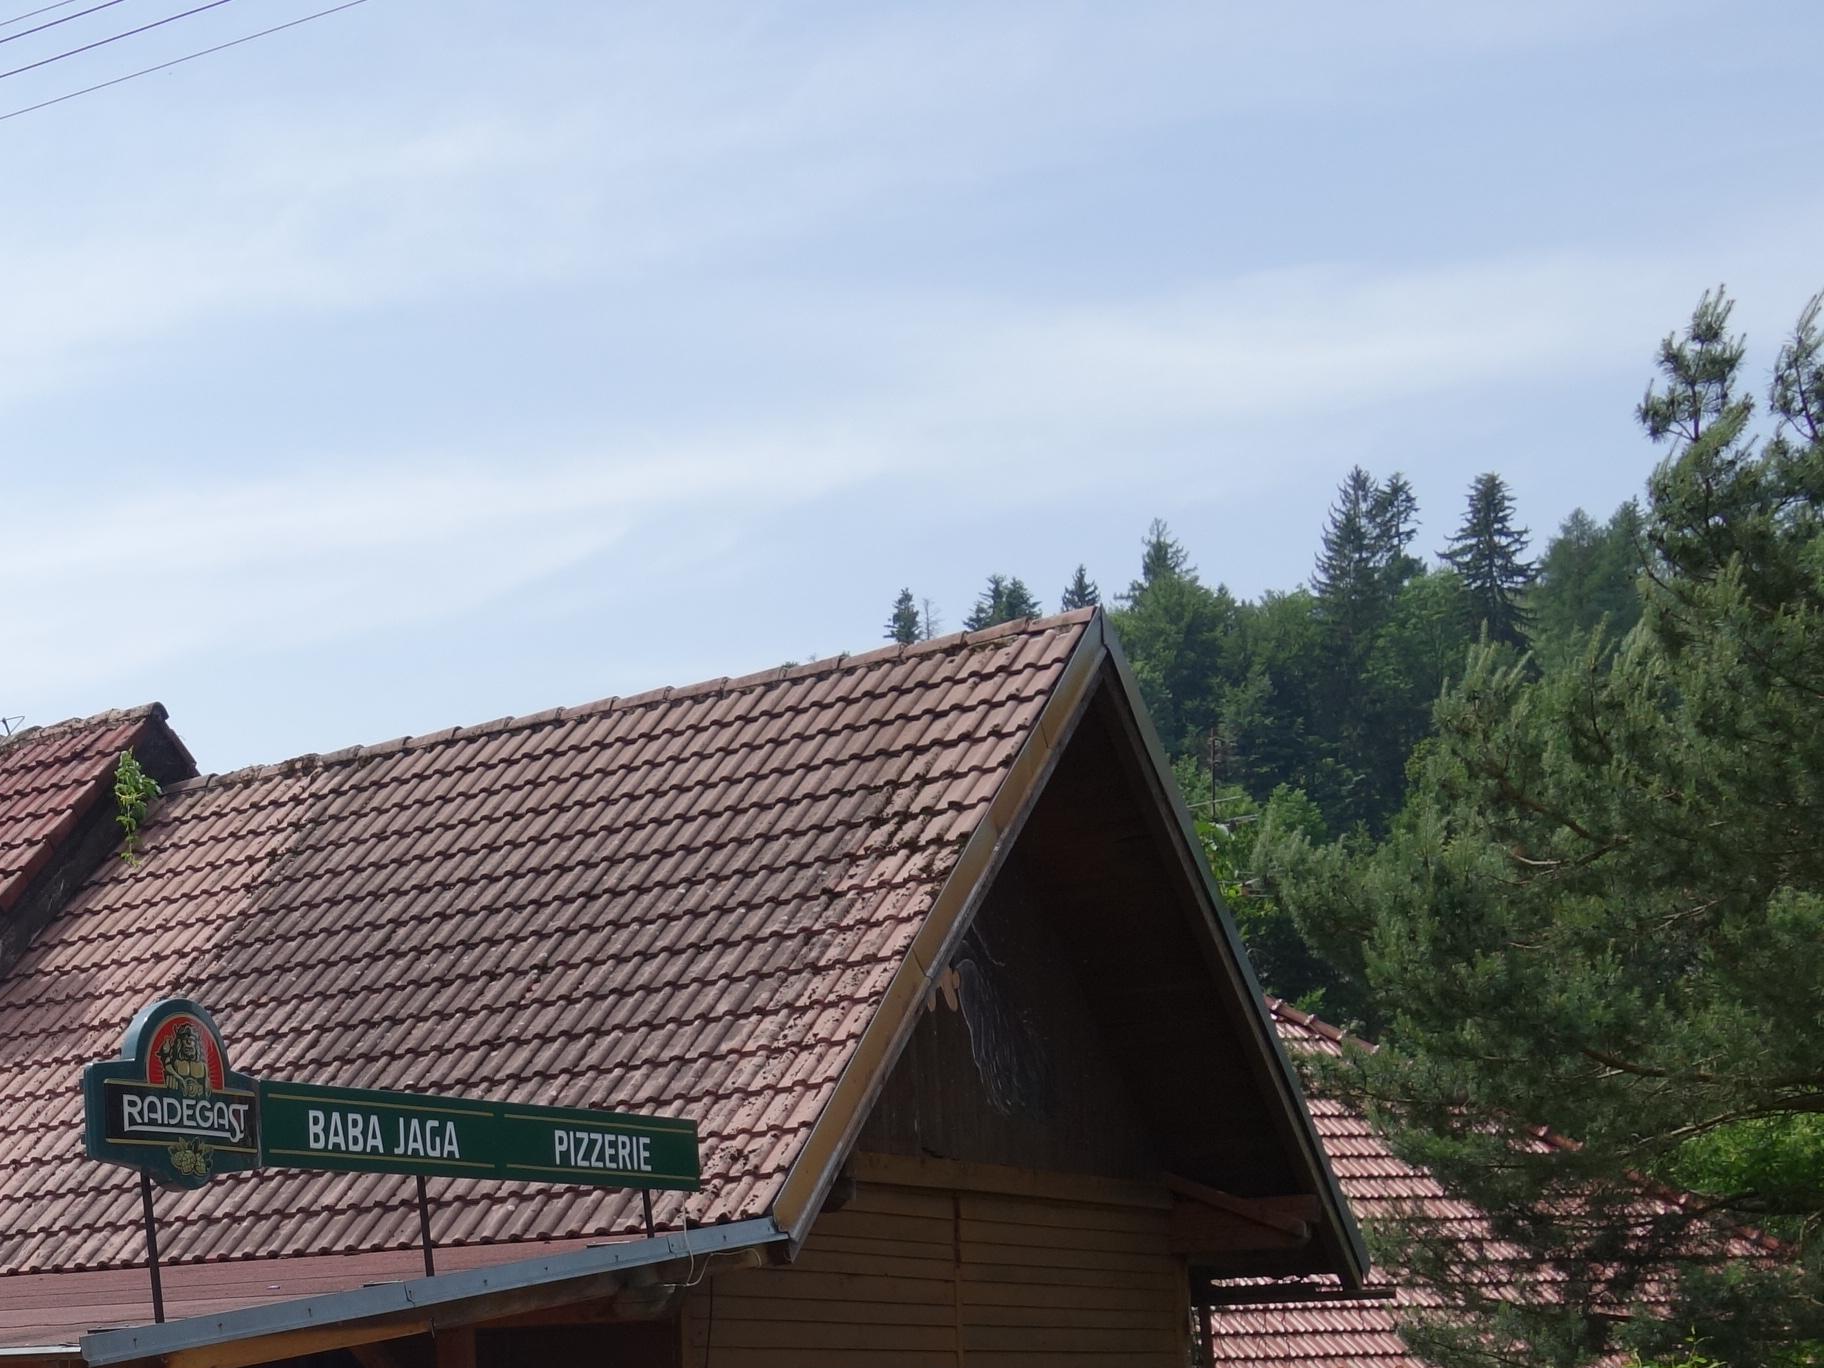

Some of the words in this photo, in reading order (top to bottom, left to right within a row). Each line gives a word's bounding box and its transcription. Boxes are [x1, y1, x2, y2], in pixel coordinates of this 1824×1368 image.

[122, 1094, 249, 1143] RADEGAST
[308, 1109, 384, 1154] BABA
[393, 1116, 461, 1159] JAGA
[554, 1129, 653, 1172] PIZZERIE
